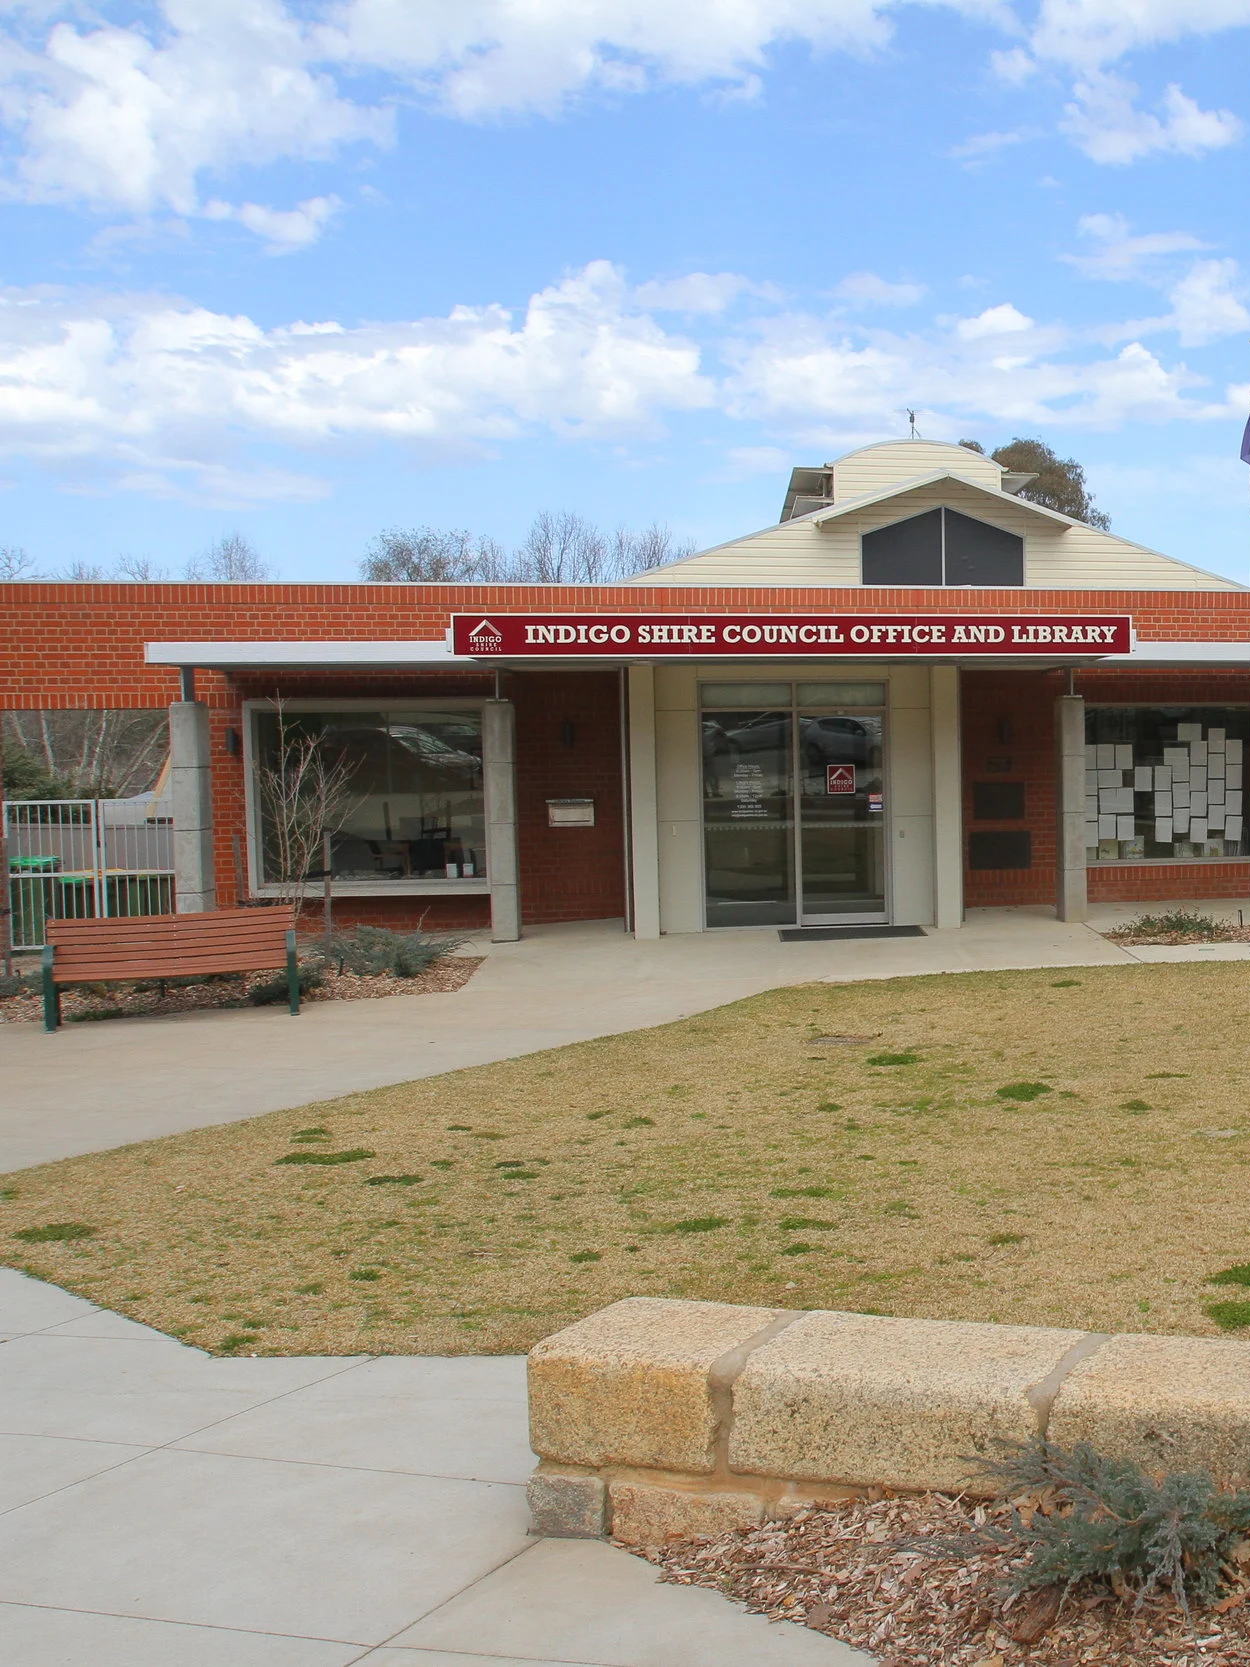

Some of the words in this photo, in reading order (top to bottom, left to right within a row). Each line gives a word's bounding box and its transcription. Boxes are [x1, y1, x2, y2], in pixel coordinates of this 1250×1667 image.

[525, 625, 631, 644] INDIGO
[638, 625, 716, 644] SHIRE
[722, 625, 844, 644] COUNCIL
[850, 625, 946, 643] OFFICE
[951, 625, 1006, 643] AND
[1011, 625, 1118, 643] LIBRARY
